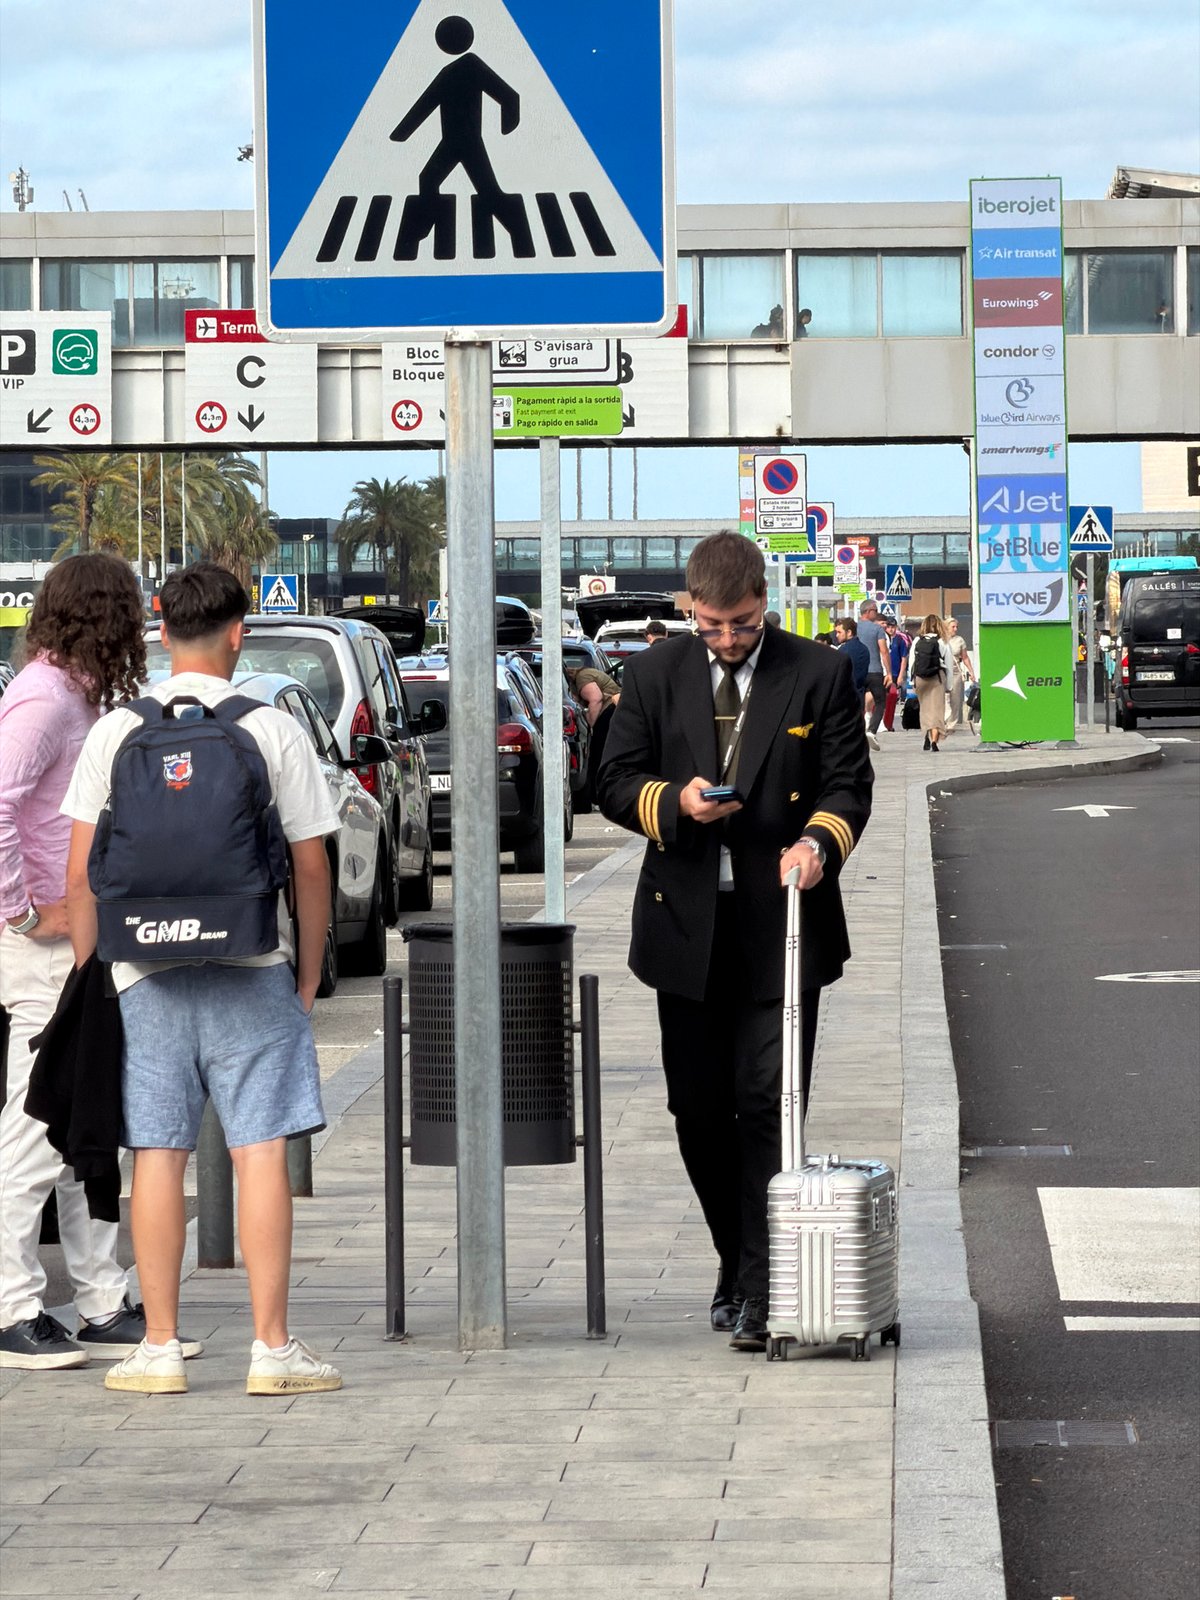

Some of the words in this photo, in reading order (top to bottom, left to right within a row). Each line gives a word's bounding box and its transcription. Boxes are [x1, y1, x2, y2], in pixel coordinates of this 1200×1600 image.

[978, 196, 1056, 215] iberojet
[993, 248, 1013, 259] Air
[1015, 248, 1056, 258] transat
[982, 298, 1039, 309] Eurowings
[534, 340, 593, 351] S'avisarà
[406, 347, 440, 359] Bloc
[983, 345, 1039, 358] condor
[549, 356, 578, 368] grua
[236, 355, 266, 389] C
[393, 369, 445, 382] Bloque
[2, 378, 25, 389] VIP
[516, 397, 556, 405] Pagament
[594, 396, 620, 404] sortida
[531, 409, 556, 417] payment
[1026, 413, 1061, 423] Airways
[517, 420, 536, 428] Pago
[981, 446, 1050, 455] smartwings
[986, 537, 1060, 562] jetBlue
[1142, 582, 1177, 590] SALLÉS
[986, 592, 1047, 606] FLYONE
[1026, 676, 1062, 687] aena
[136, 918, 201, 944] GMB
[200, 931, 228, 940] BRAND
